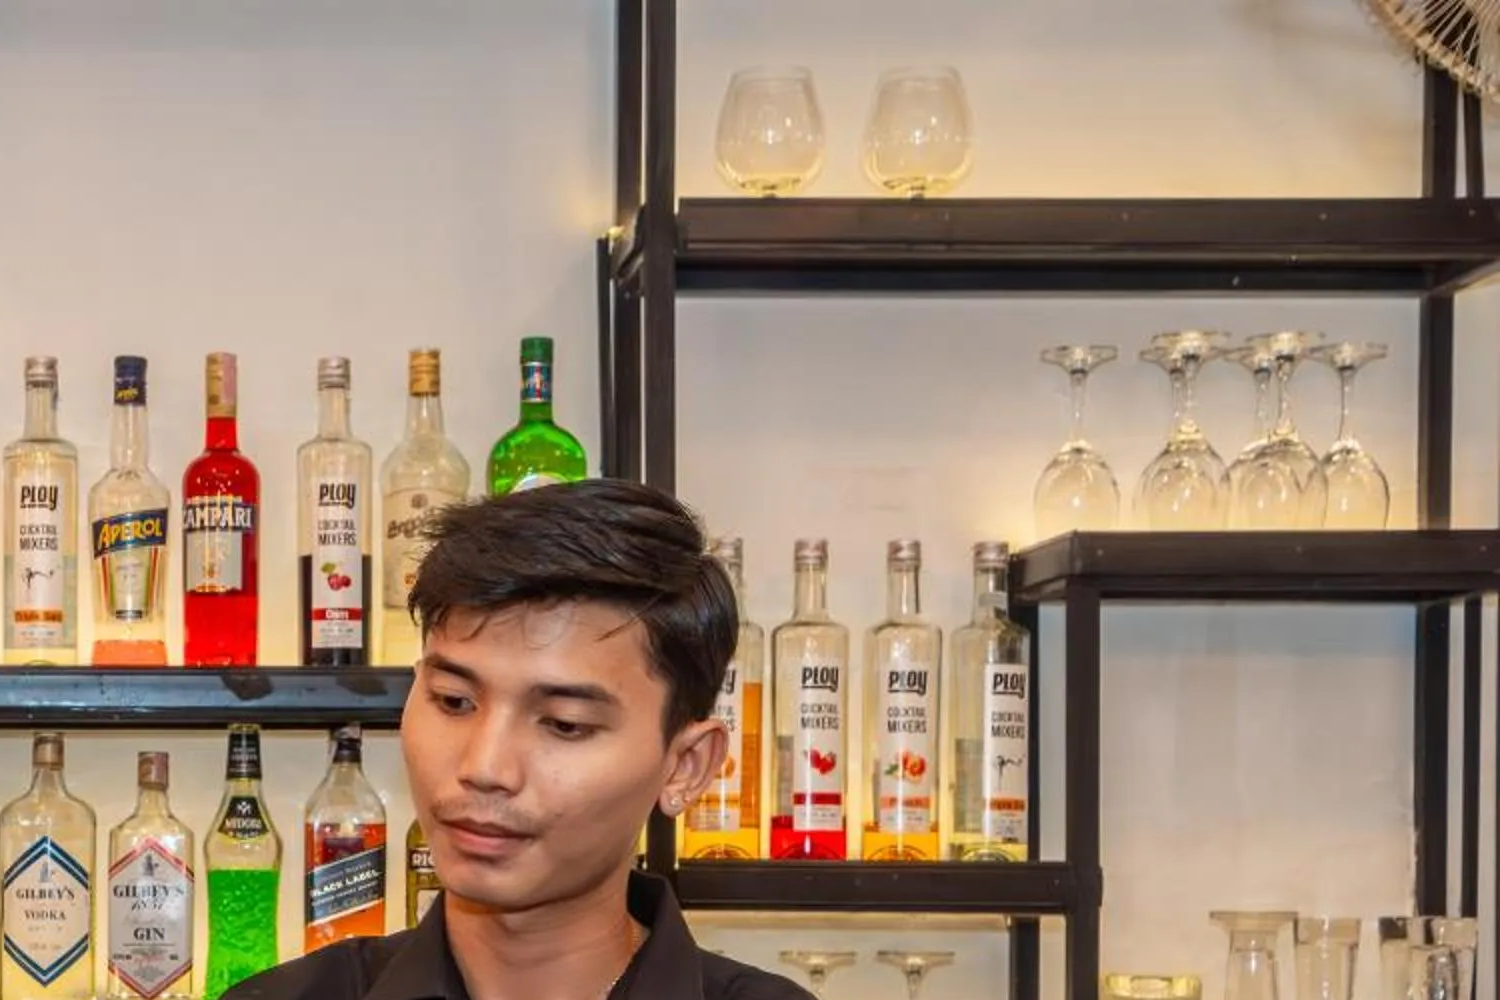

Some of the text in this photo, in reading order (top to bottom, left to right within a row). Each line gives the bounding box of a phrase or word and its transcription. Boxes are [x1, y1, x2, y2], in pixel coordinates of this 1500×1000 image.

[97, 517, 163, 551] APEROL
[317, 532, 357, 547] MIXERS
[19, 536, 59, 551] MIXERS
[801, 716, 840, 730] MIXERS
[887, 719, 928, 734] MIXERS
[15, 885, 75, 900] GILBEY'S
[23, 909, 67, 921] VODKA
[132, 926, 166, 941] GIN
